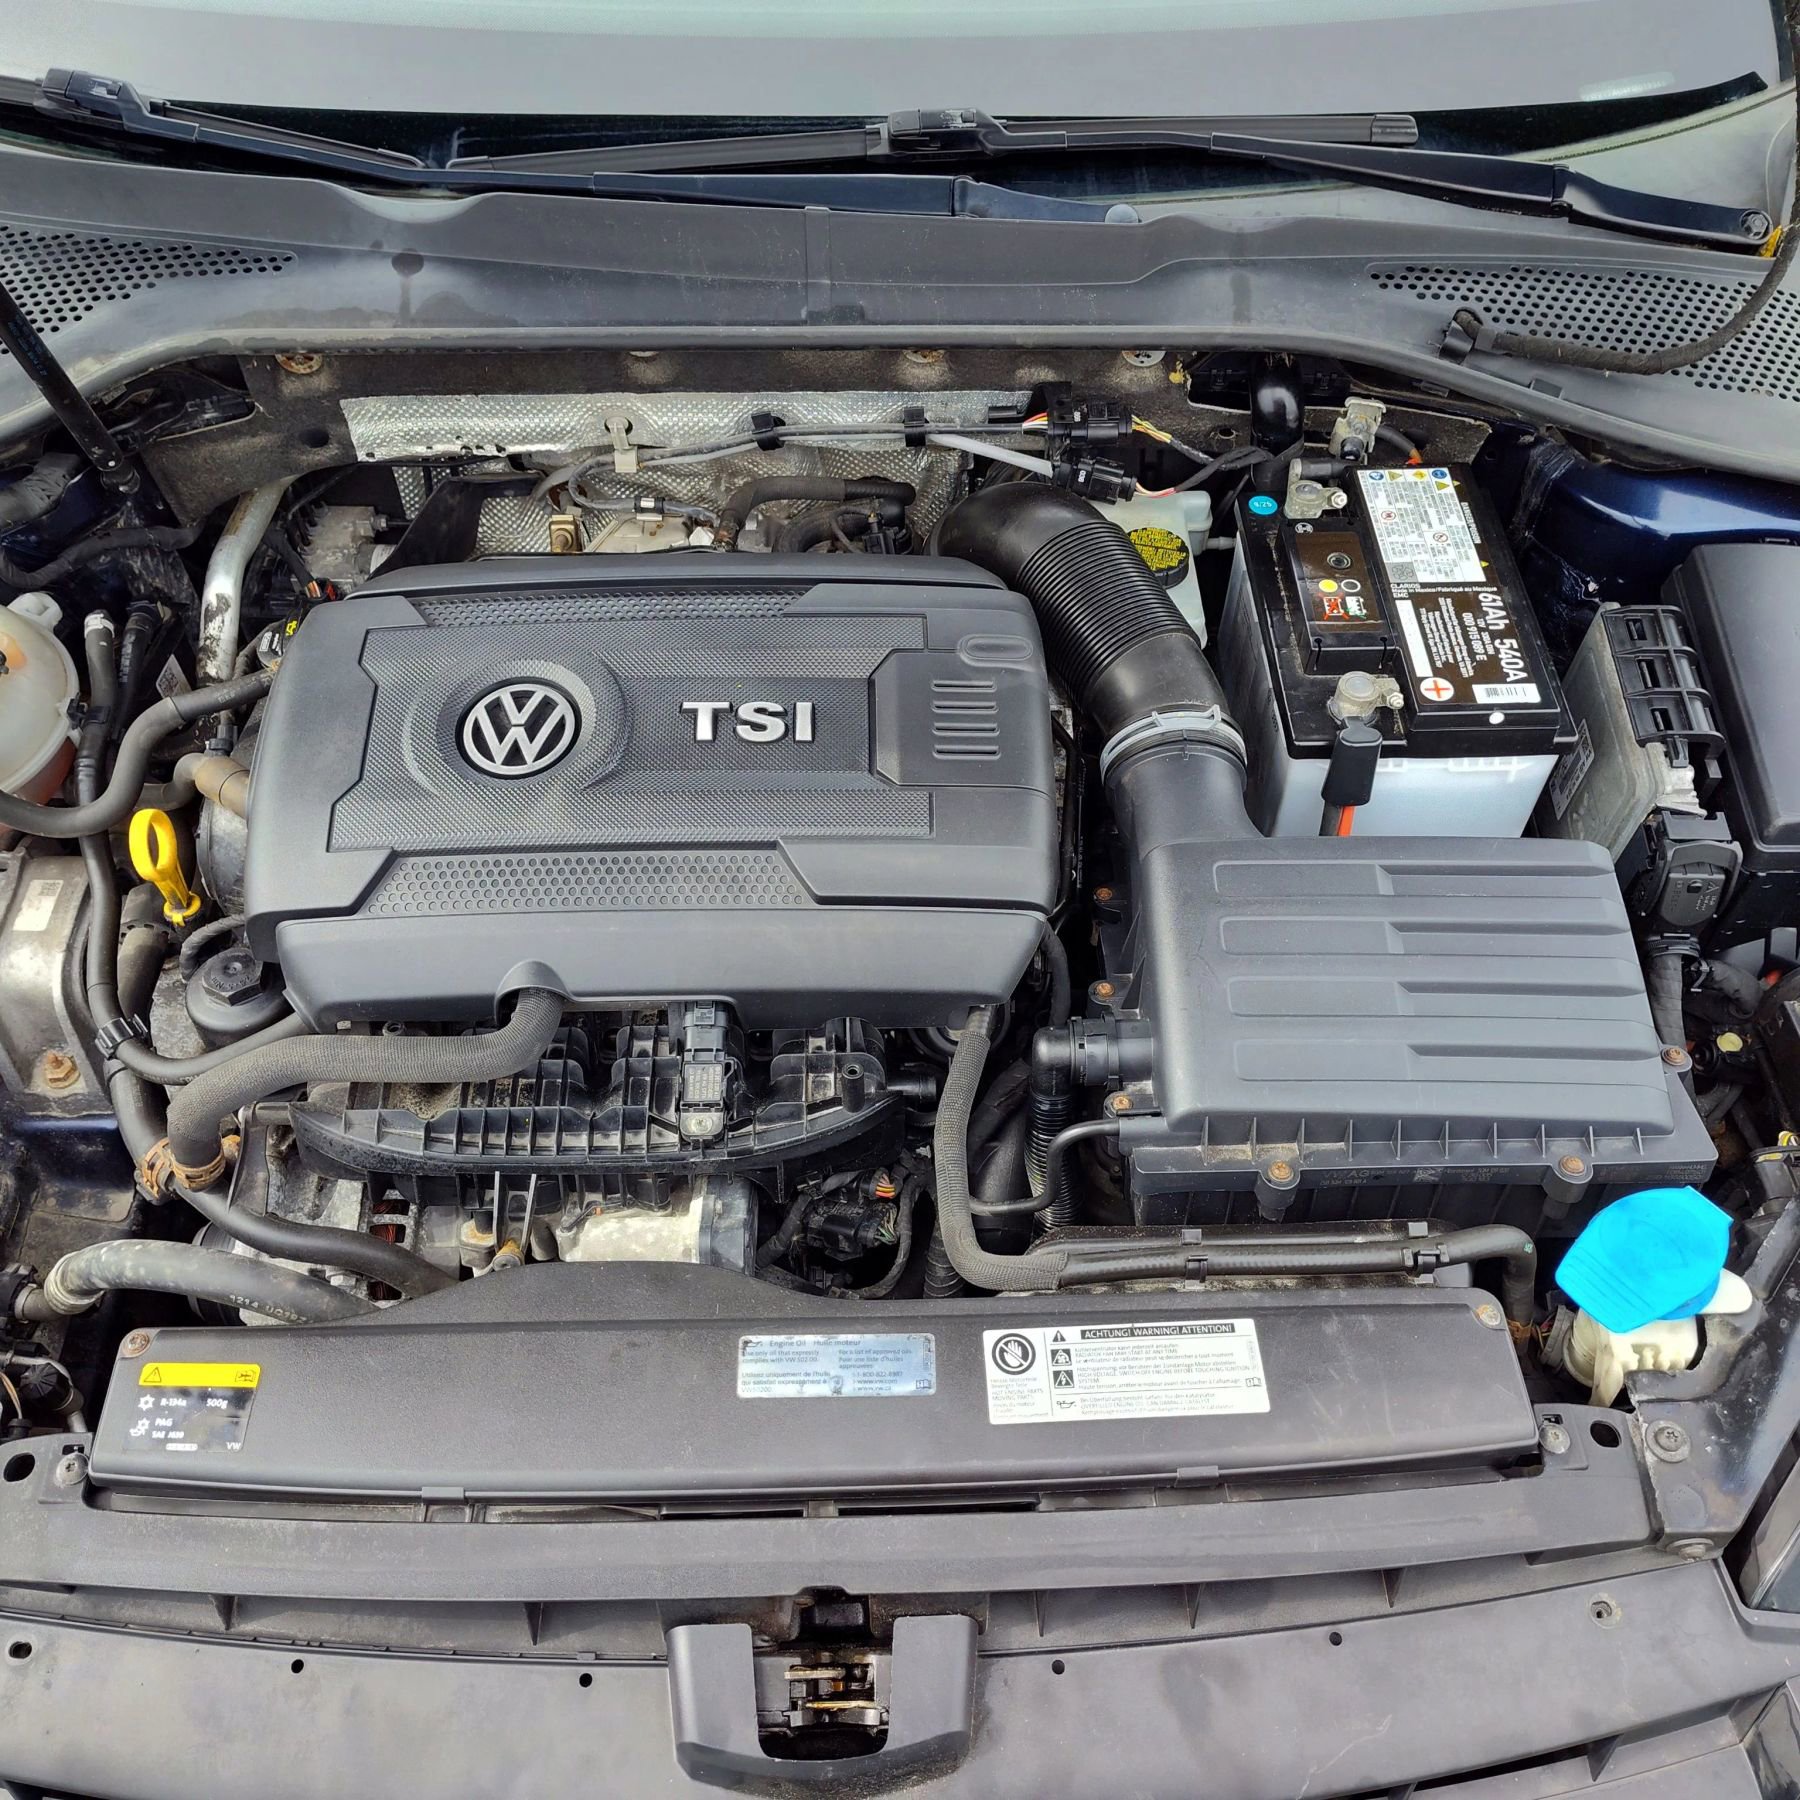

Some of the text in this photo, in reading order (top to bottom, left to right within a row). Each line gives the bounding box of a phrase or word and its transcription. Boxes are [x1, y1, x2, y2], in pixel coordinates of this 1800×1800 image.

[1467, 626, 1480, 639] 915
[1478, 592, 1528, 682] 61Ah 540A
[680, 700, 816, 744] TSI
[1085, 1324, 1232, 1338] ACHTUNG! WARNING! ATTENTION!
[770, 1340, 794, 1348] Engine
[160, 1398, 228, 1409] R-134a 500g
[155, 1418, 173, 1427] PAG
[226, 1442, 242, 1450] VW
